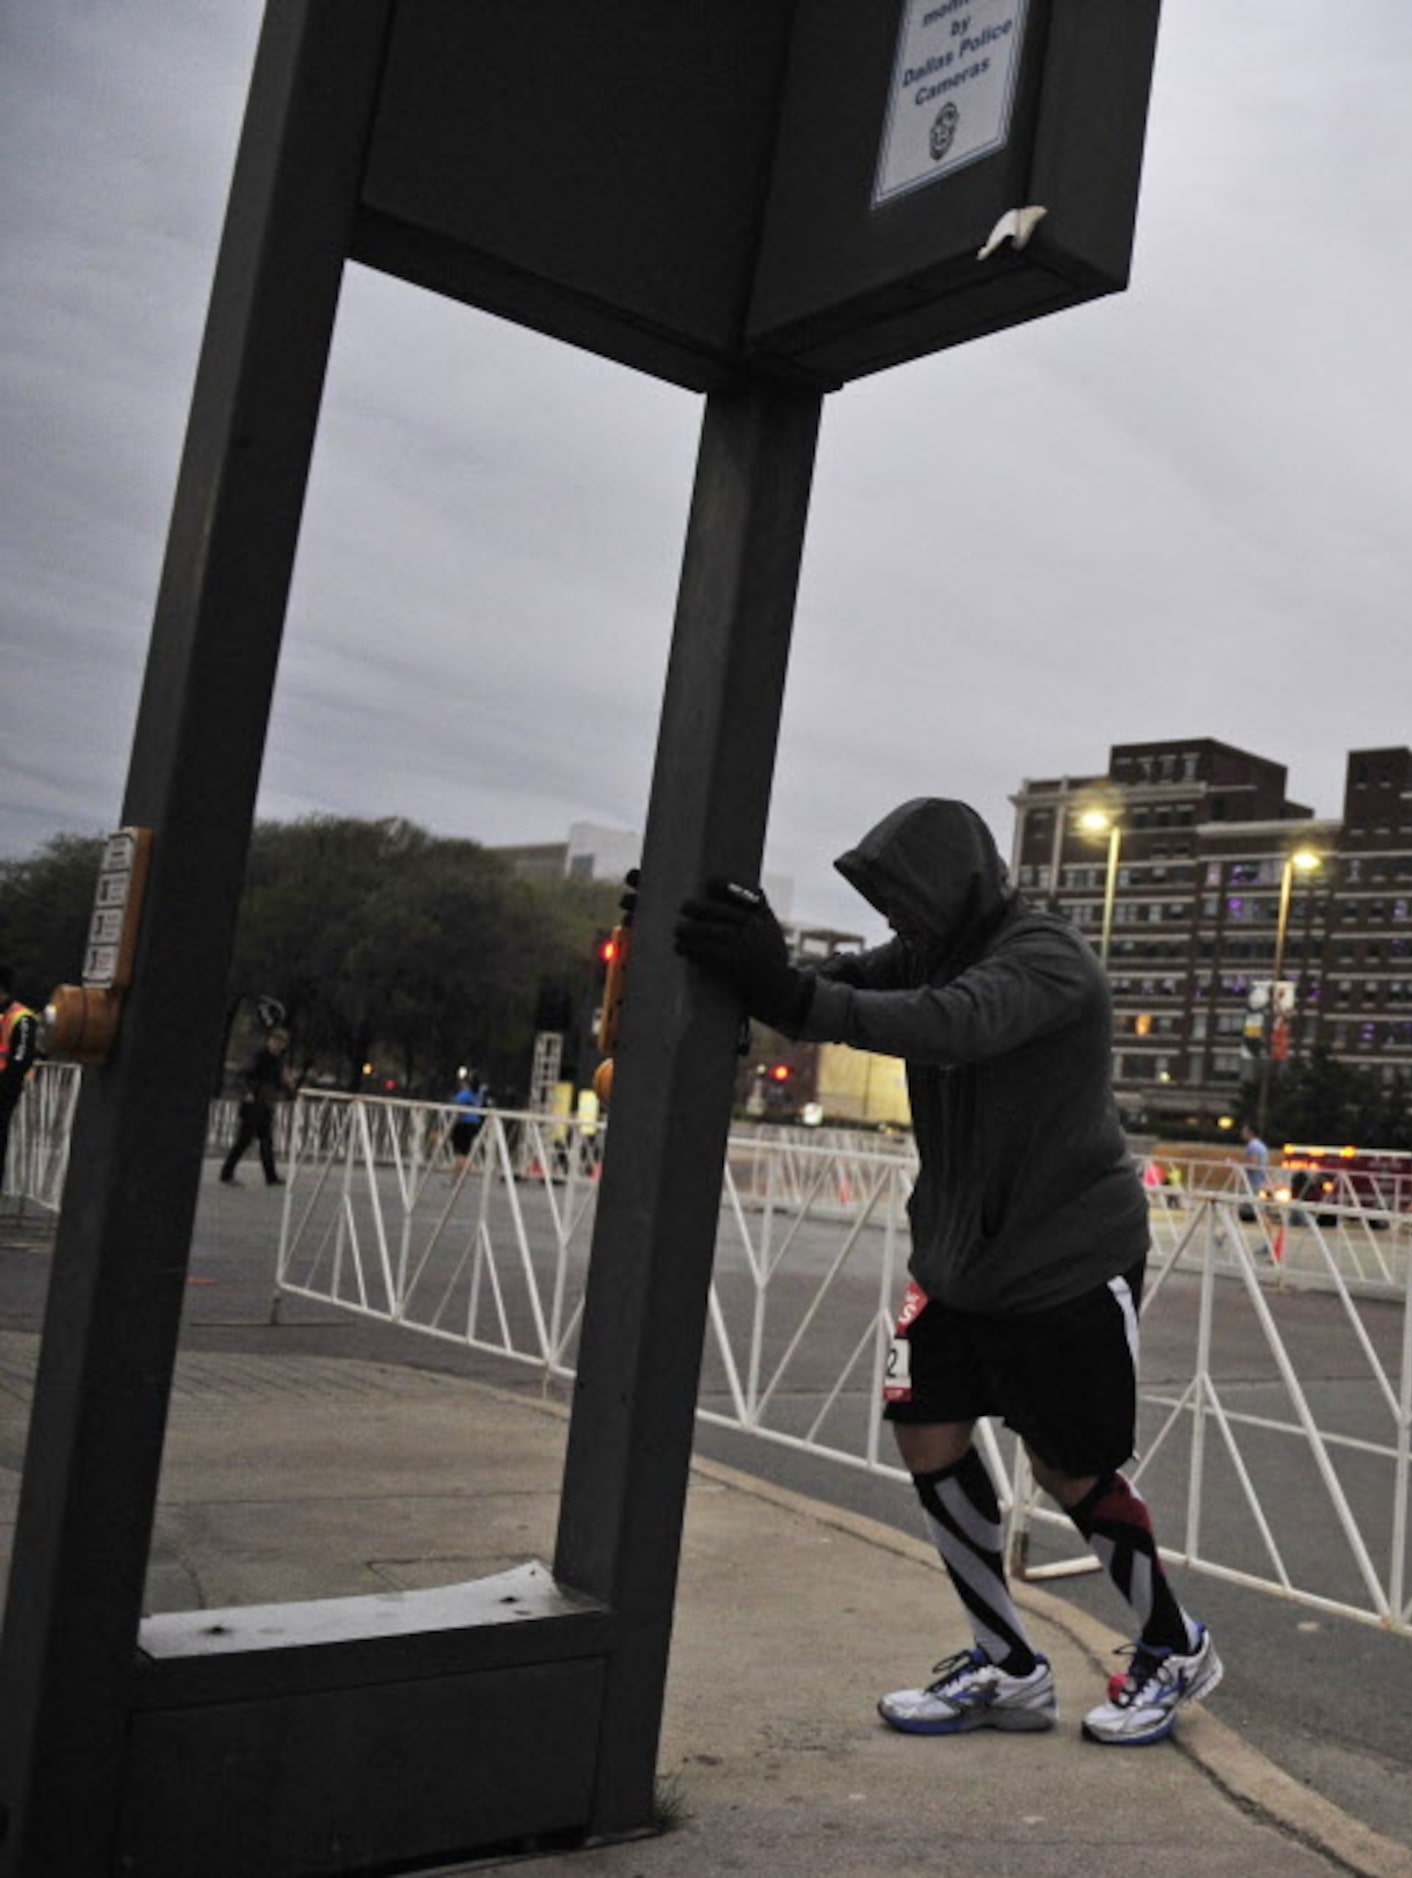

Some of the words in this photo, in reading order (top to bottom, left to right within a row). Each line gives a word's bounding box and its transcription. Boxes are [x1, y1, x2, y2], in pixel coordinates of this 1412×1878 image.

[951, 16, 971, 36] by
[902, 51, 954, 88] Dallas
[959, 18, 1012, 58] Police
[914, 58, 990, 105] Cameras
